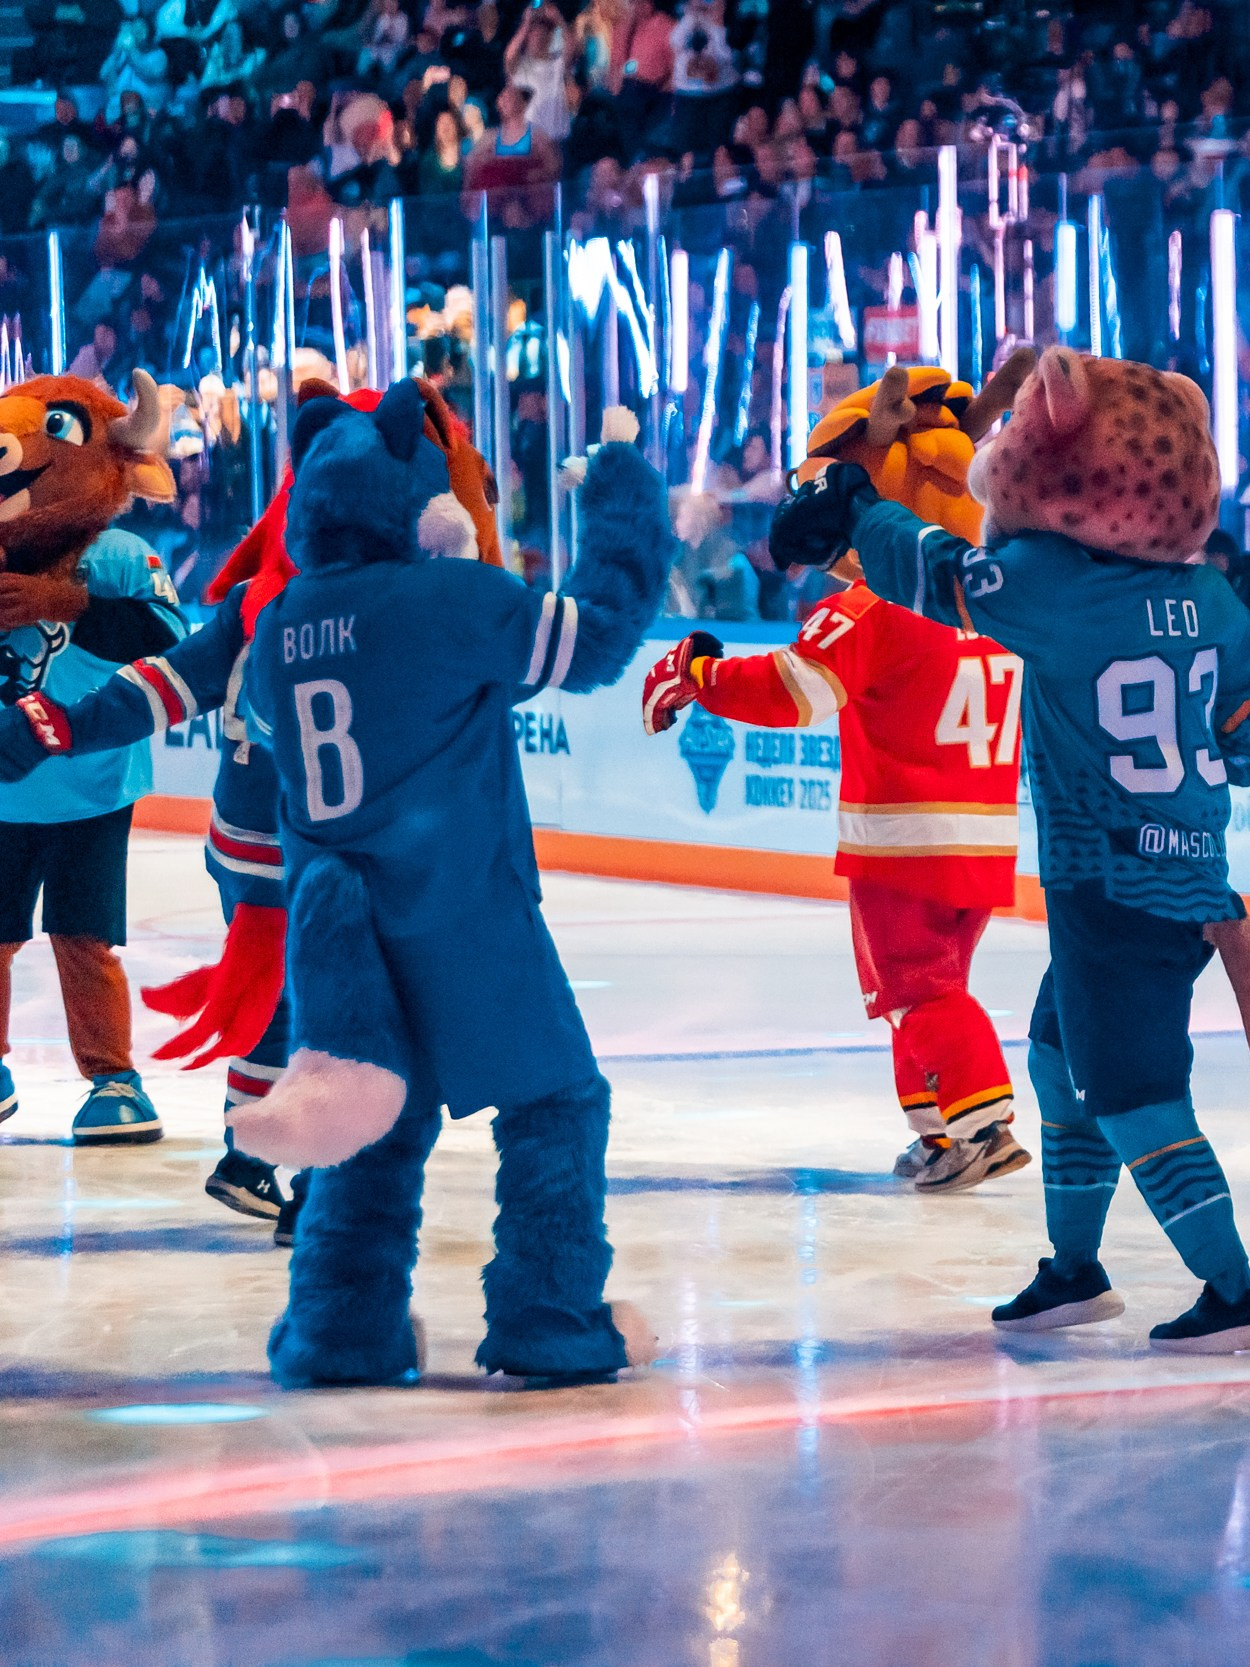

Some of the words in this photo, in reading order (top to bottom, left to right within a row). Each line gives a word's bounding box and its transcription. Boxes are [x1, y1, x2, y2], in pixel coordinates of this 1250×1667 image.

[283, 614, 358, 664] ВОЛК
[800, 607, 856, 650] 47
[1146, 599, 1199, 637] LEO
[935, 653, 1024, 769] 47
[1096, 647, 1228, 794] 93
